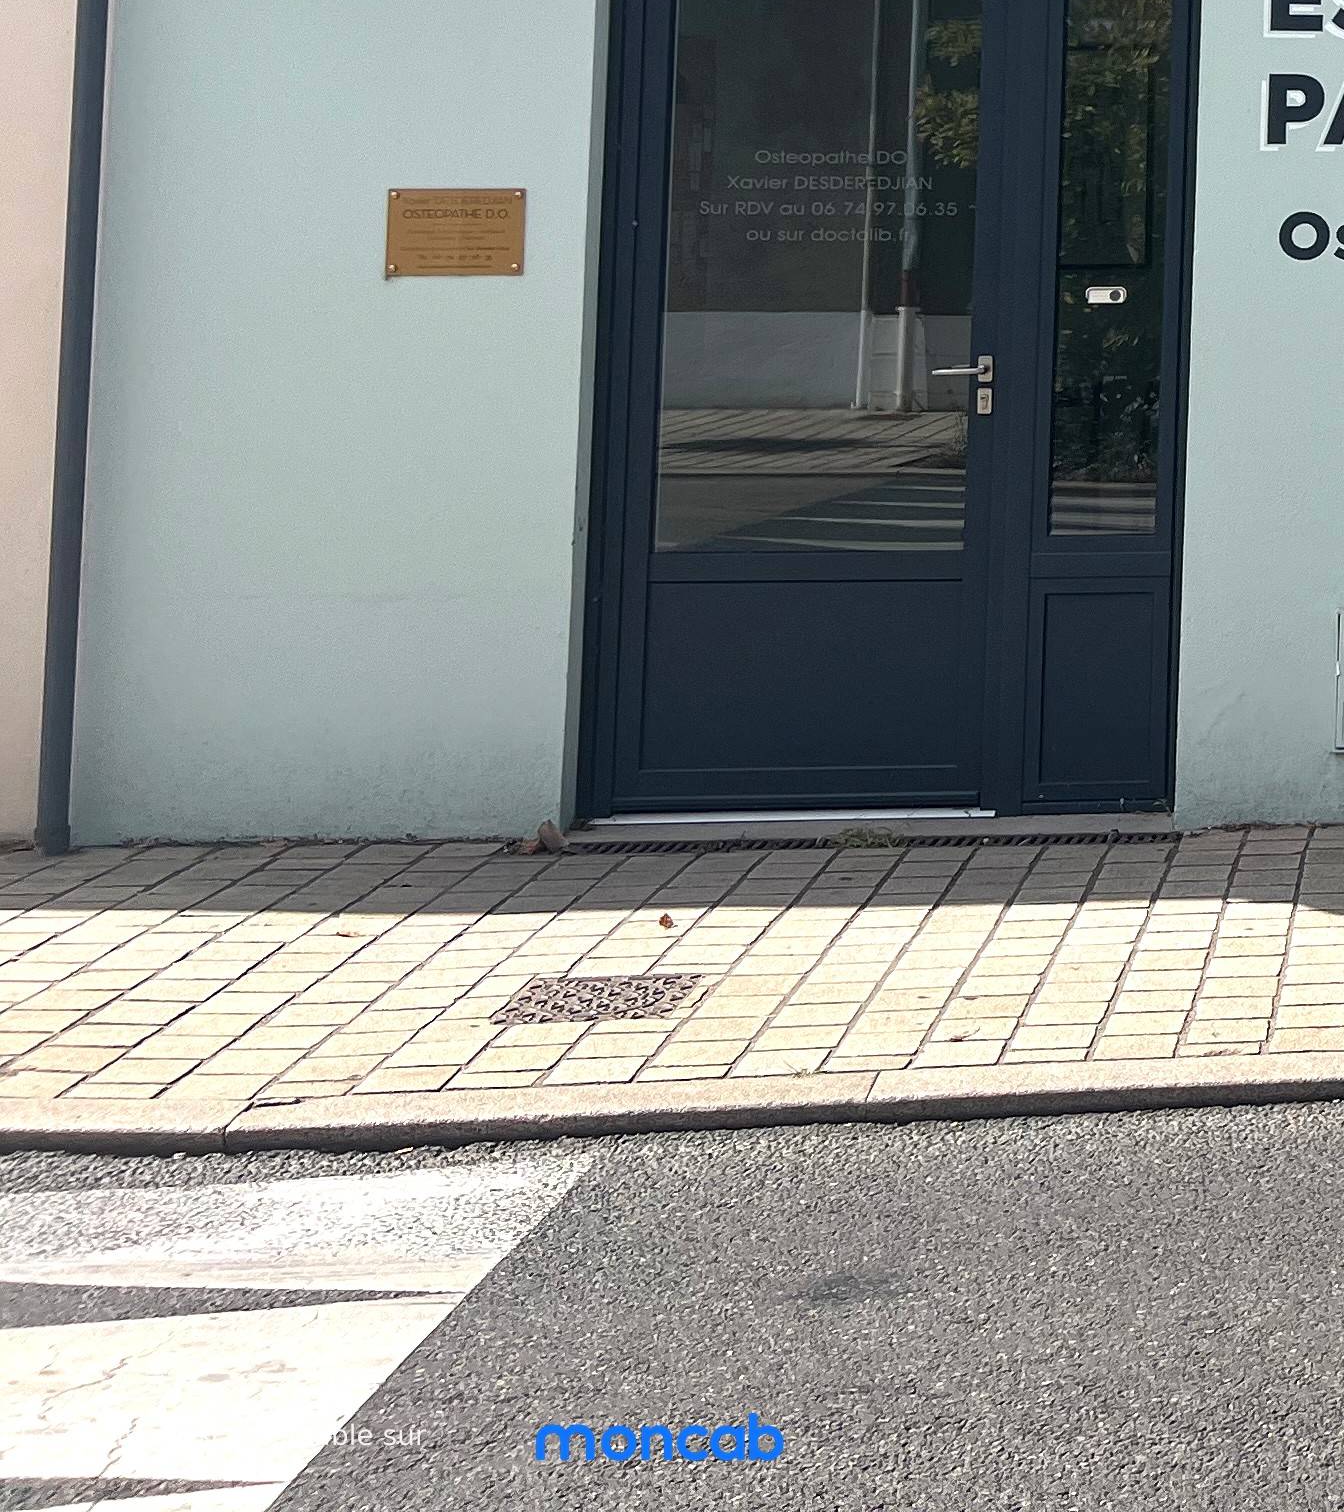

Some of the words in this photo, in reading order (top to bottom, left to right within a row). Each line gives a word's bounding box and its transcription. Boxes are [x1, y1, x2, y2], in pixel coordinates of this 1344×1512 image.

[876, 150, 908, 165] DO
[727, 174, 788, 190] Xavier
[698, 200, 729, 216] Sur
[734, 200, 775, 216] RDV
[778, 203, 806, 216] au
[810, 200, 958, 217] 06.7497.06.35
[746, 230, 771, 241] ou
[777, 230, 804, 241] sur
